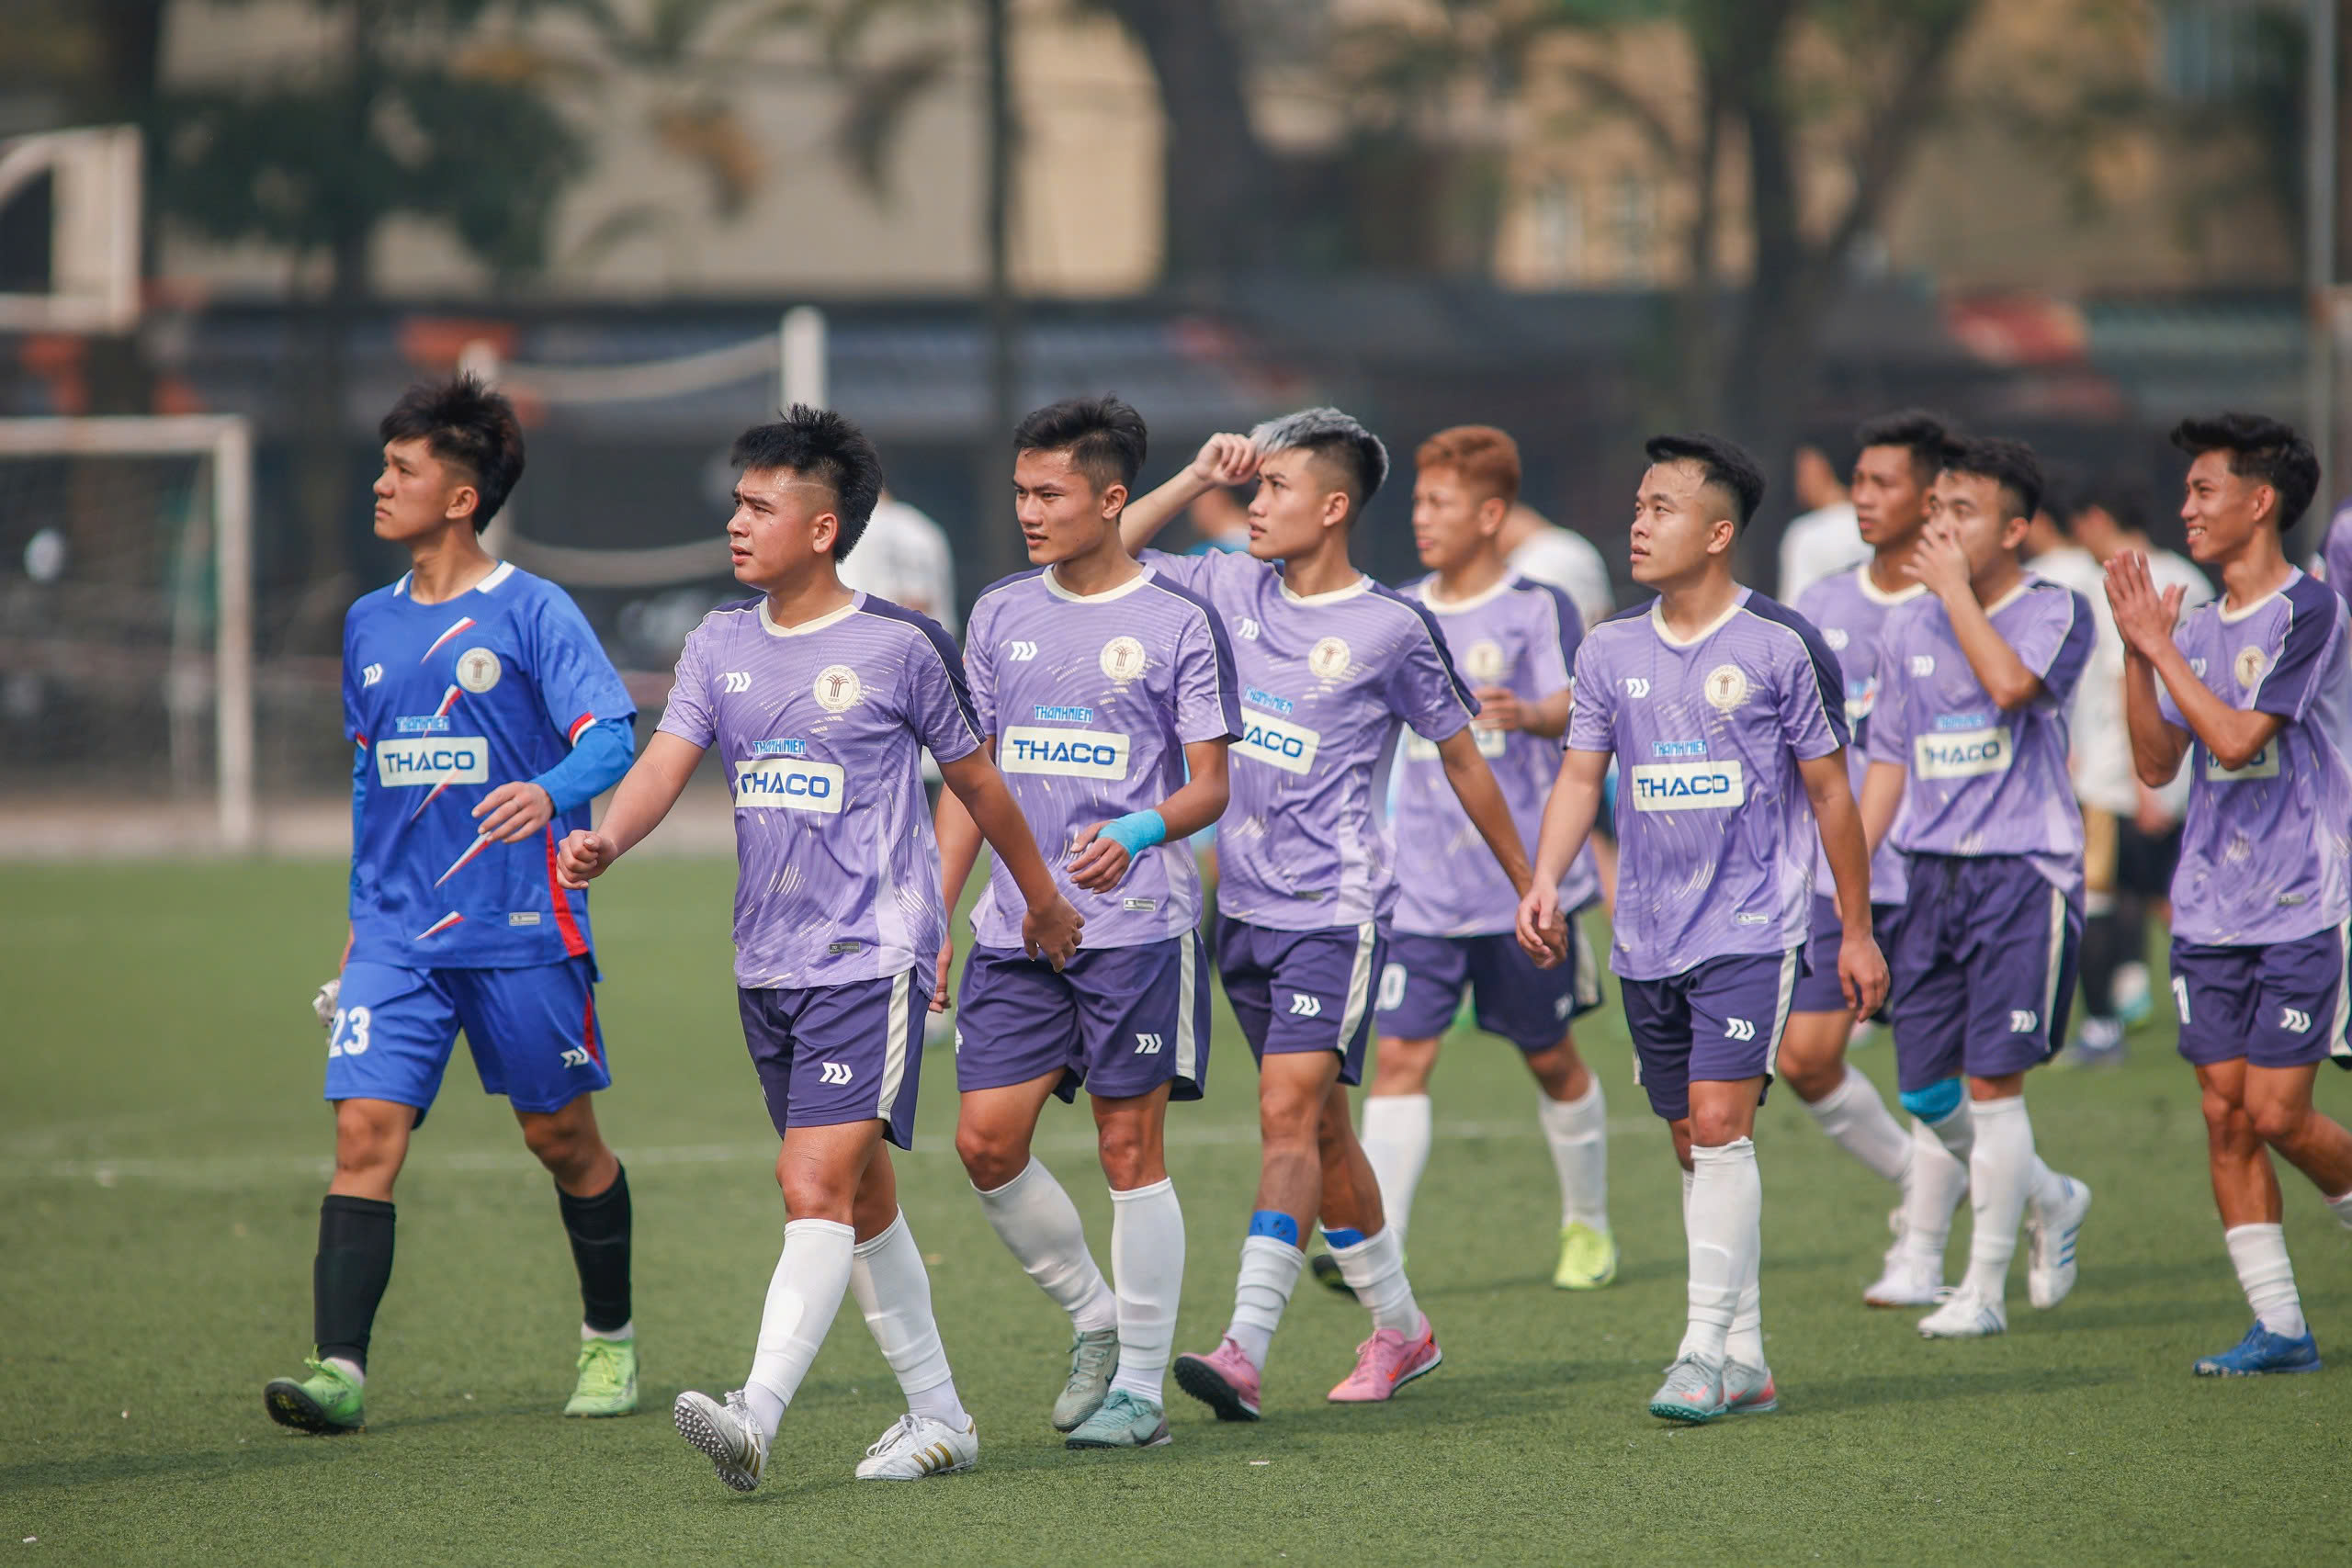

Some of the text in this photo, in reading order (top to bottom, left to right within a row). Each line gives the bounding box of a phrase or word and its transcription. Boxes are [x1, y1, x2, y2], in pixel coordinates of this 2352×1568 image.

[1012, 739, 1115, 765] THACO
[1244, 720, 1303, 758] ACO
[383, 750, 475, 773] THACO
[741, 772, 831, 798] THACO
[1637, 774, 1729, 797] THACO
[1374, 962, 1408, 1010] 0
[329, 1006, 371, 1058] 23
